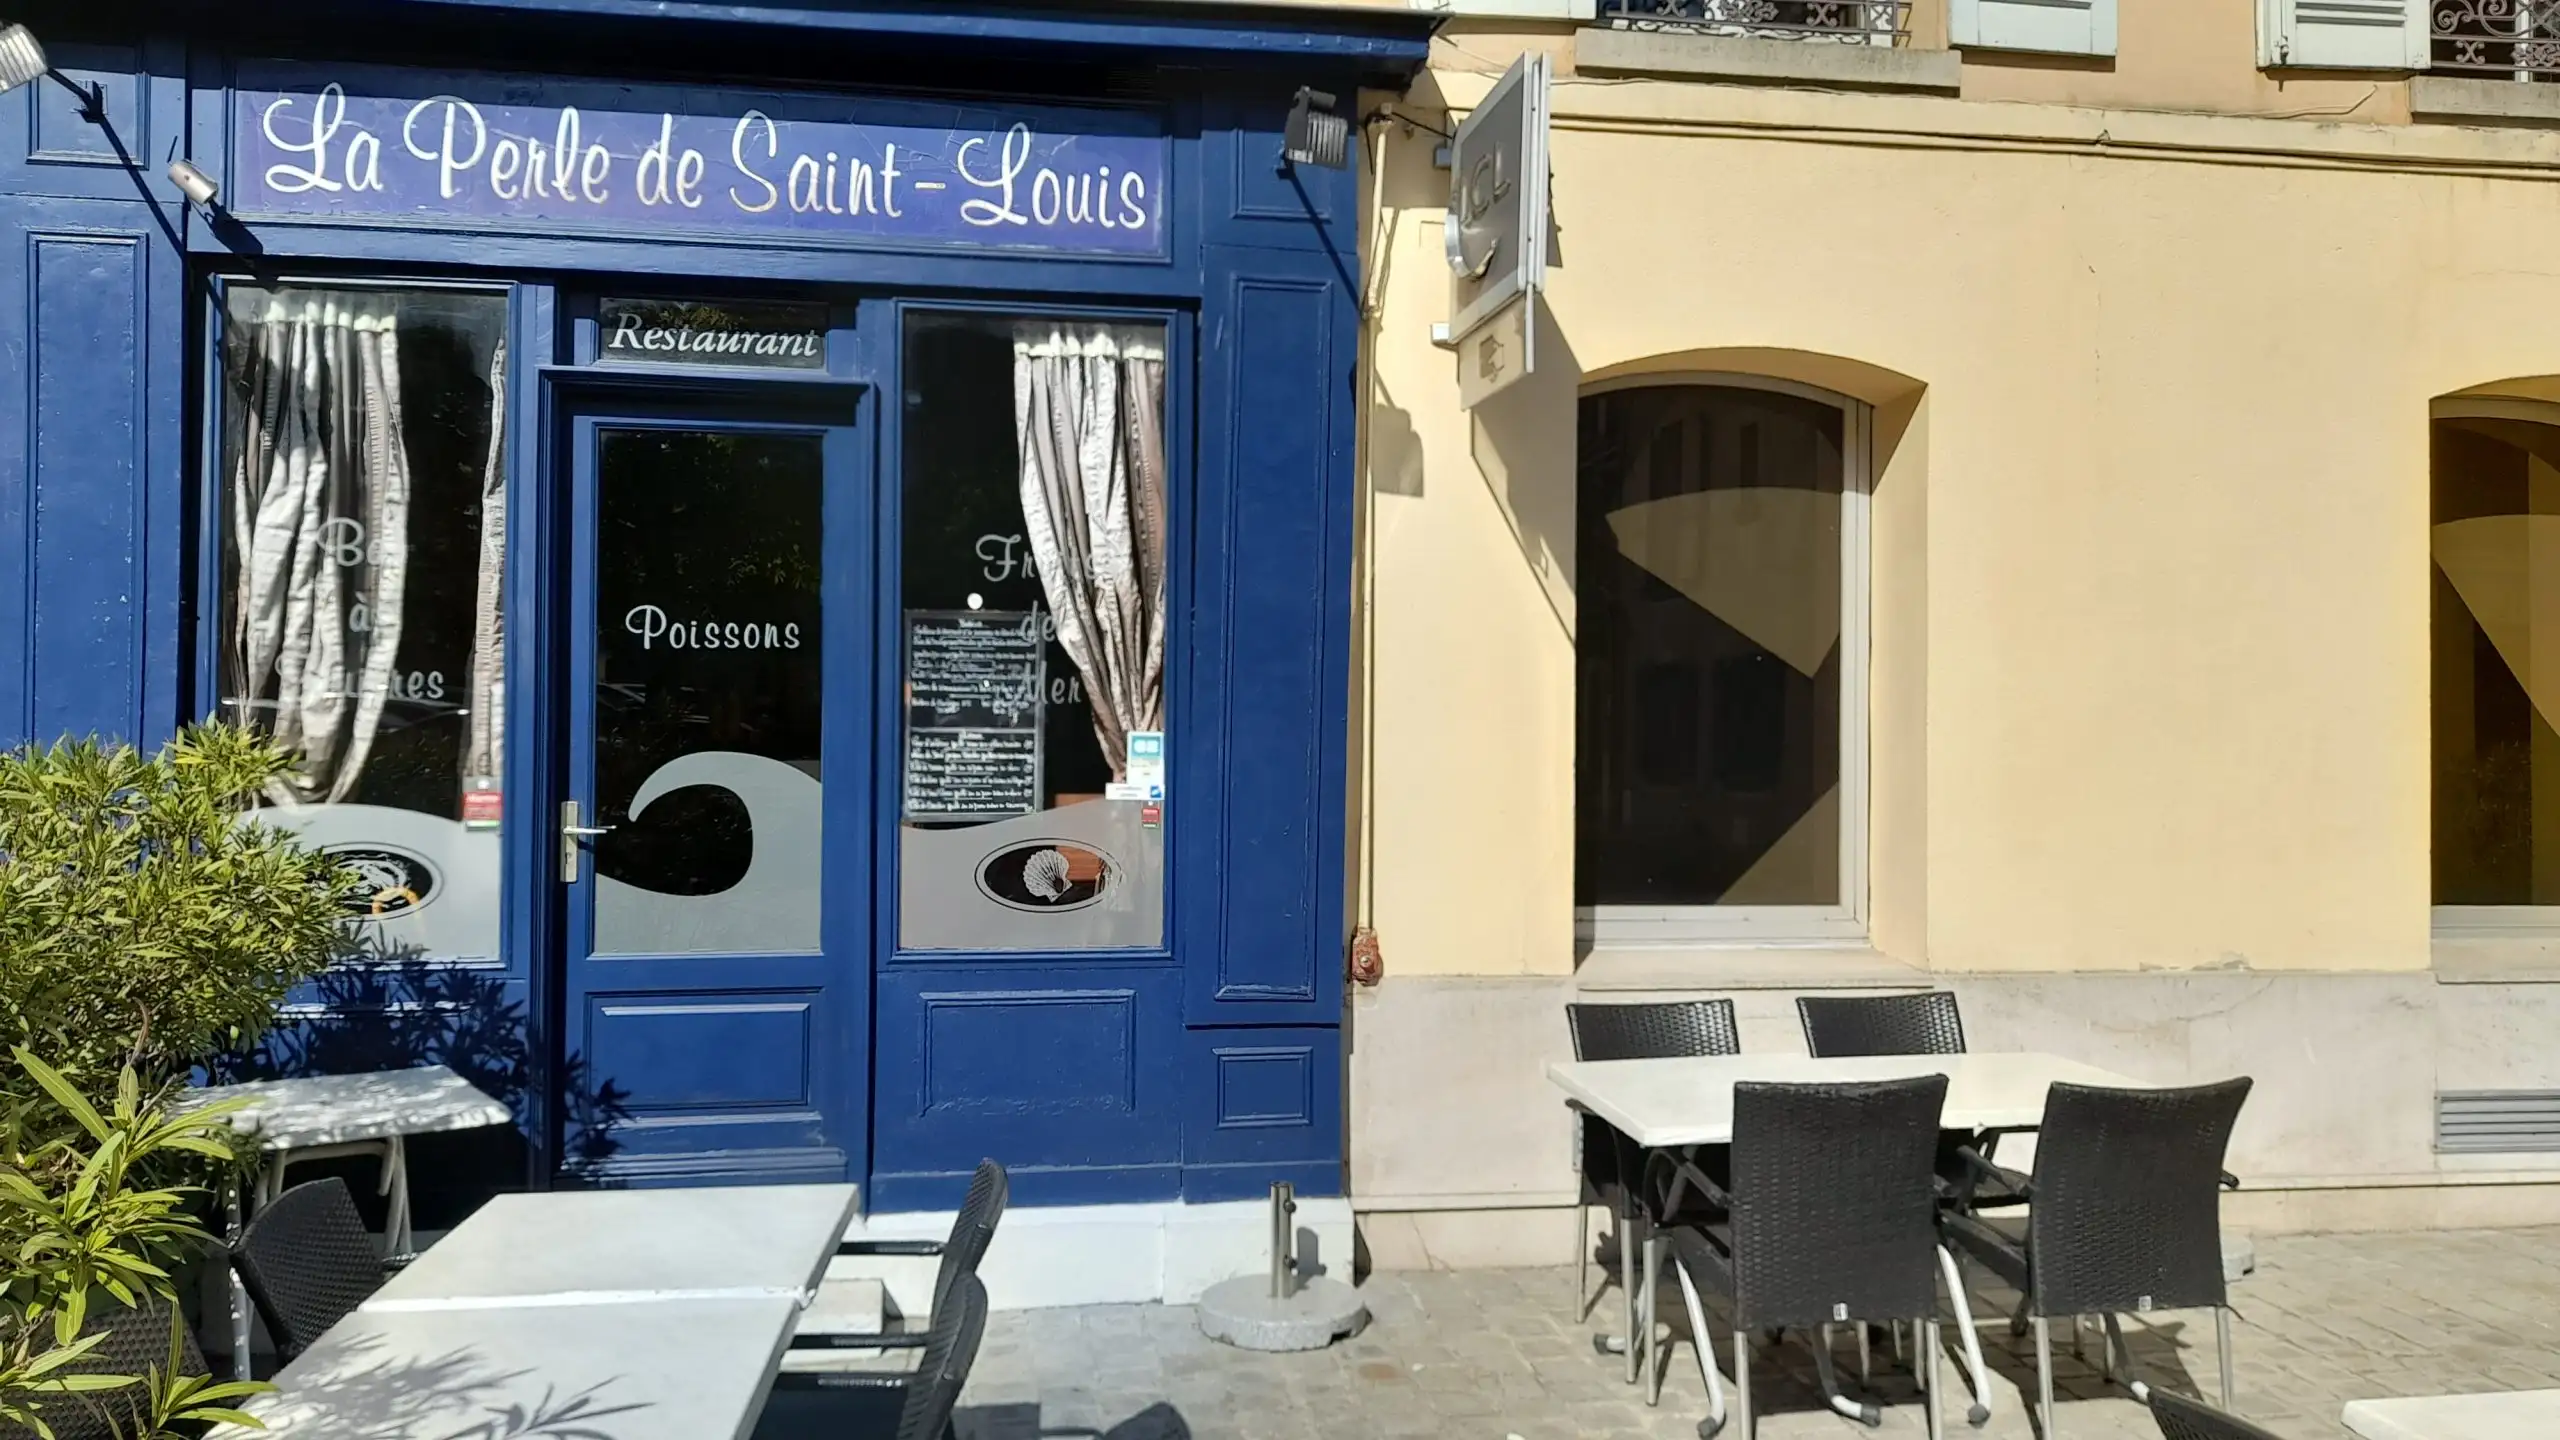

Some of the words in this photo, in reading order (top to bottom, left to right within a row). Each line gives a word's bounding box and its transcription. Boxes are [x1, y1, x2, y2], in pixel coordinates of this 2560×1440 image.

[262, 82, 384, 193] La
[403, 95, 611, 204] Perle
[636, 113, 704, 208] de
[608, 312, 819, 357] Restaurant
[625, 604, 801, 650] Poissons
[1021, 600, 1058, 642] de
